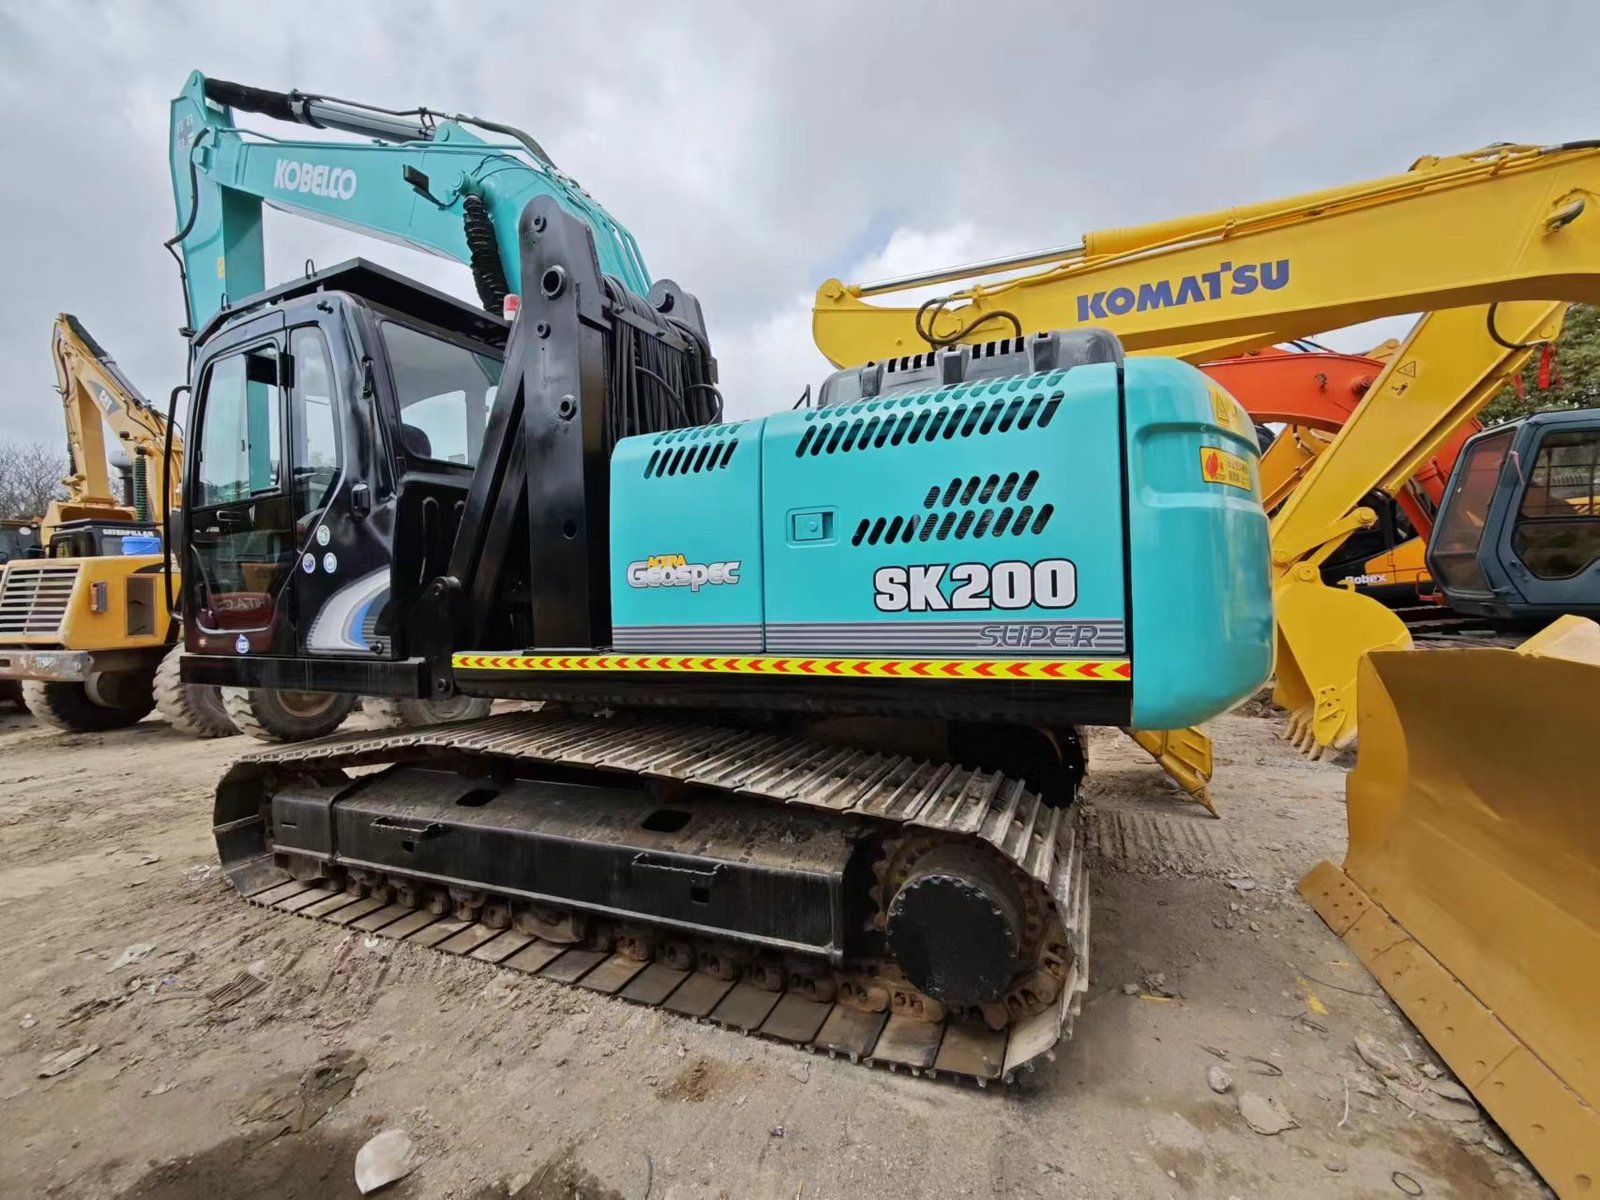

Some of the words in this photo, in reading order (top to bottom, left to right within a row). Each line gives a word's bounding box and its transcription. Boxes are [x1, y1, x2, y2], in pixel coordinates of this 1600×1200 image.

[273, 158, 357, 200] KOBELCO
[1077, 259, 1290, 322] KOMATSU
[873, 557, 1078, 613] SK200
[976, 624, 1099, 648] SUPER
